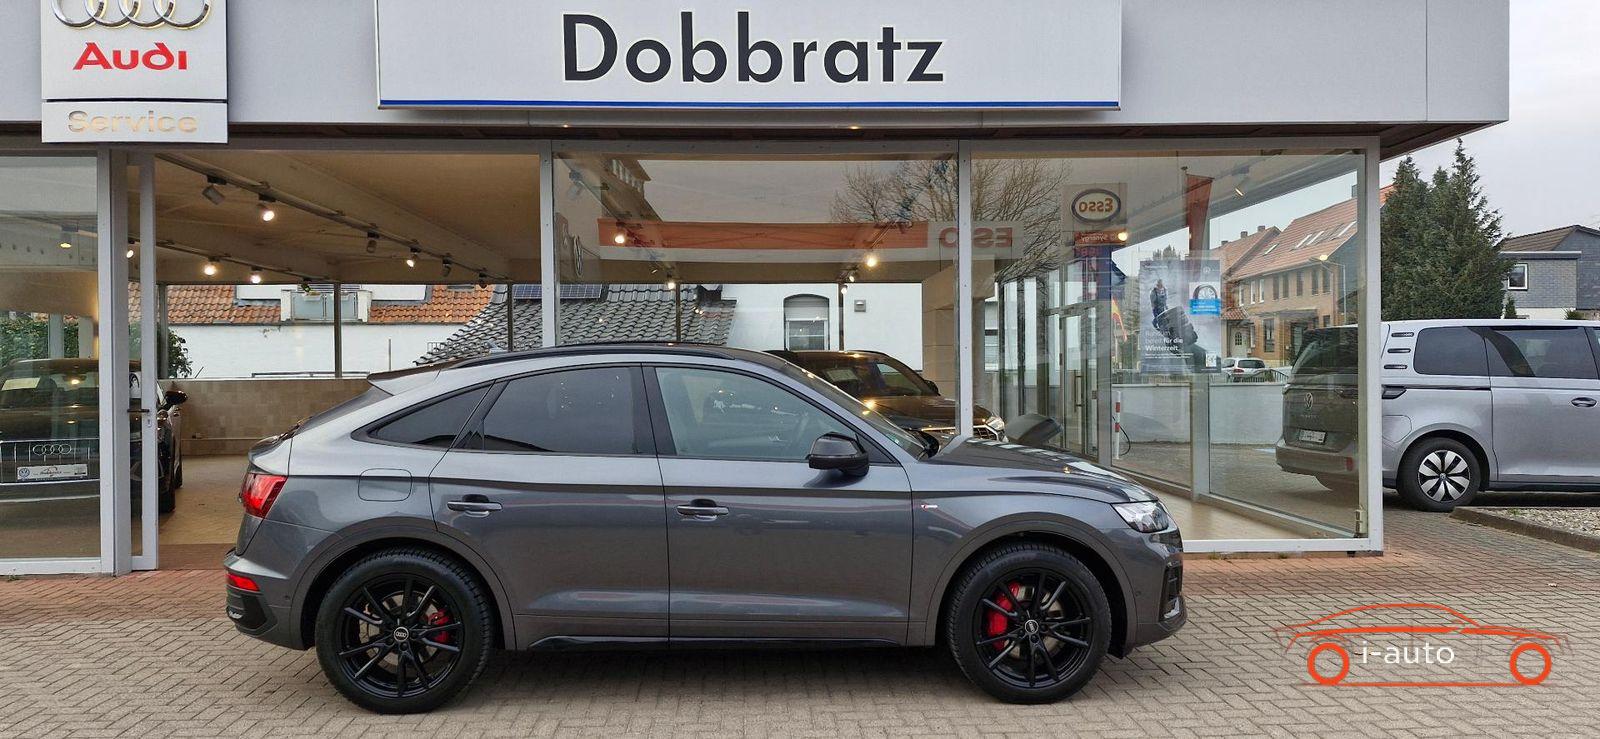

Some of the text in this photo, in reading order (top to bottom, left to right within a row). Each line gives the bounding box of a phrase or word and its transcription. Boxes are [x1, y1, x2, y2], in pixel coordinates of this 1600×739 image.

[72, 42, 188, 70] Audi
[563, 12, 944, 83] Dobbratz
[68, 110, 198, 134] Service
